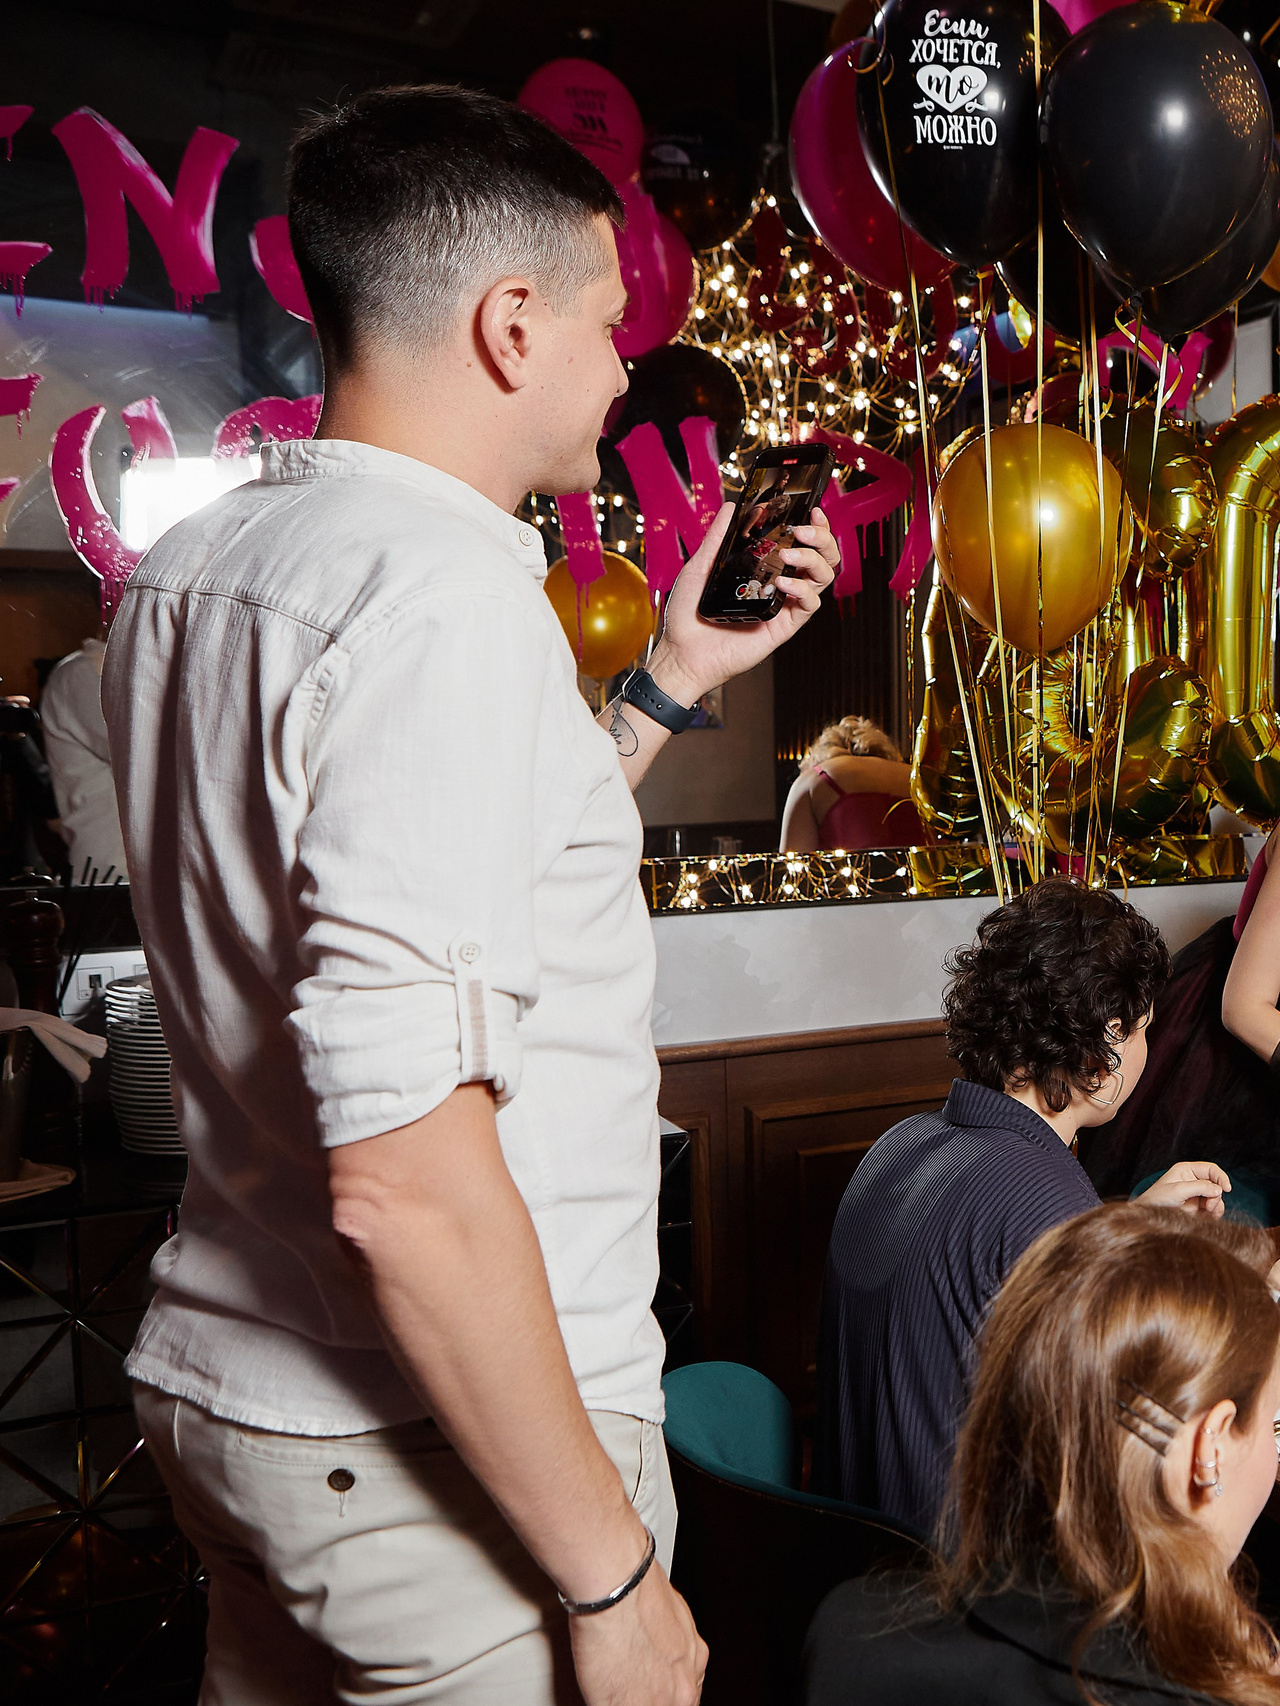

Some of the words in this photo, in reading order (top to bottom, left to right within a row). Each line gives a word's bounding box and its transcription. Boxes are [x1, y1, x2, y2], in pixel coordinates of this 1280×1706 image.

[923, 8, 989, 39] Если
[908, 38, 1001, 69] ХОЧЕТСЯ,
[913, 114, 997, 146] МОЖНО
